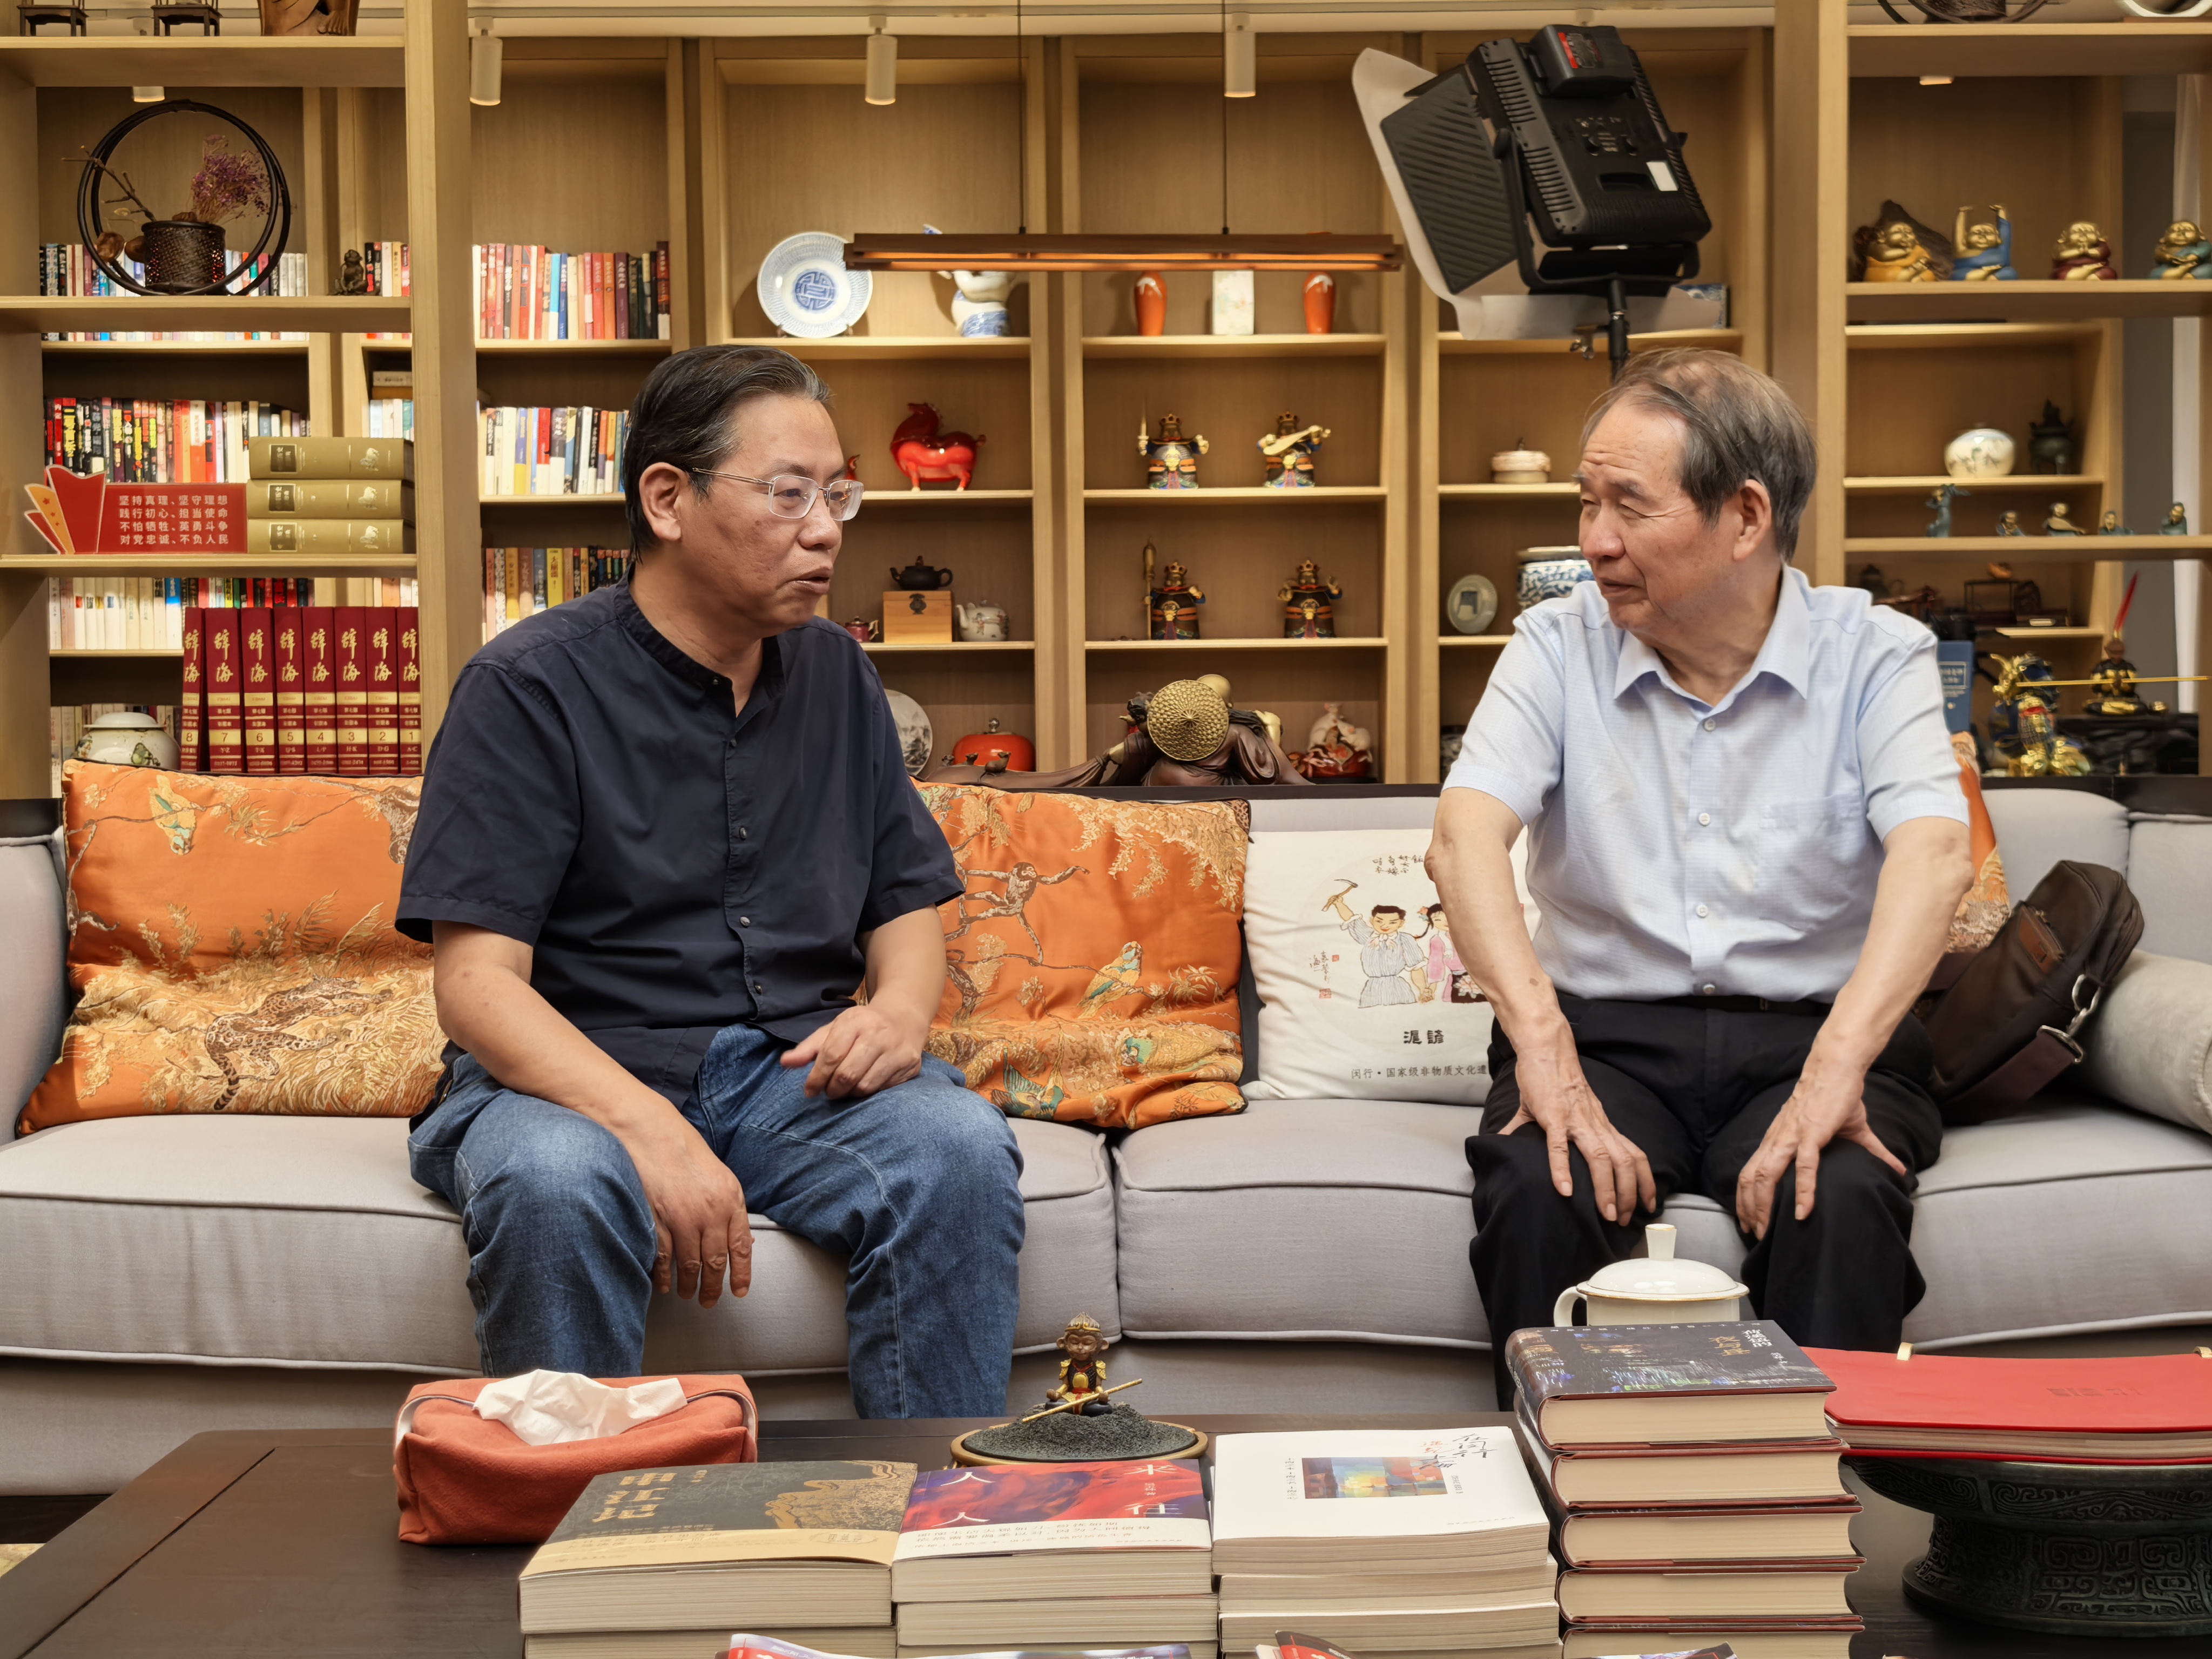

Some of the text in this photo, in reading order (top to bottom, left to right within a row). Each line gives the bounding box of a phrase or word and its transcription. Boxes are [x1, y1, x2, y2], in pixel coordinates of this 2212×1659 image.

[119, 495, 228, 505] 坚持真理、坚守理想
[119, 508, 228, 519] 践行初心、担当使命
[120, 521, 228, 532] 不怕牺牲、英勇斗争
[120, 534, 229, 545] 对党忠诚、不负人民
[185, 629, 200, 683] 辞海
[214, 629, 233, 683] 辞海
[248, 629, 268, 683] 辞海
[280, 629, 299, 682] 辞海
[311, 628, 329, 682] 辞海
[341, 628, 360, 681] 辞海
[373, 628, 392, 681] 辞海
[402, 628, 420, 681] 辞海
[186, 732, 193, 742] 8
[222, 732, 228, 743] 7
[257, 733, 264, 742] 6
[287, 732, 294, 741] 5
[318, 732, 323, 741] 4
[348, 732, 355, 741] 3
[380, 732, 386, 741] 2
[409, 732, 414, 741] 1
